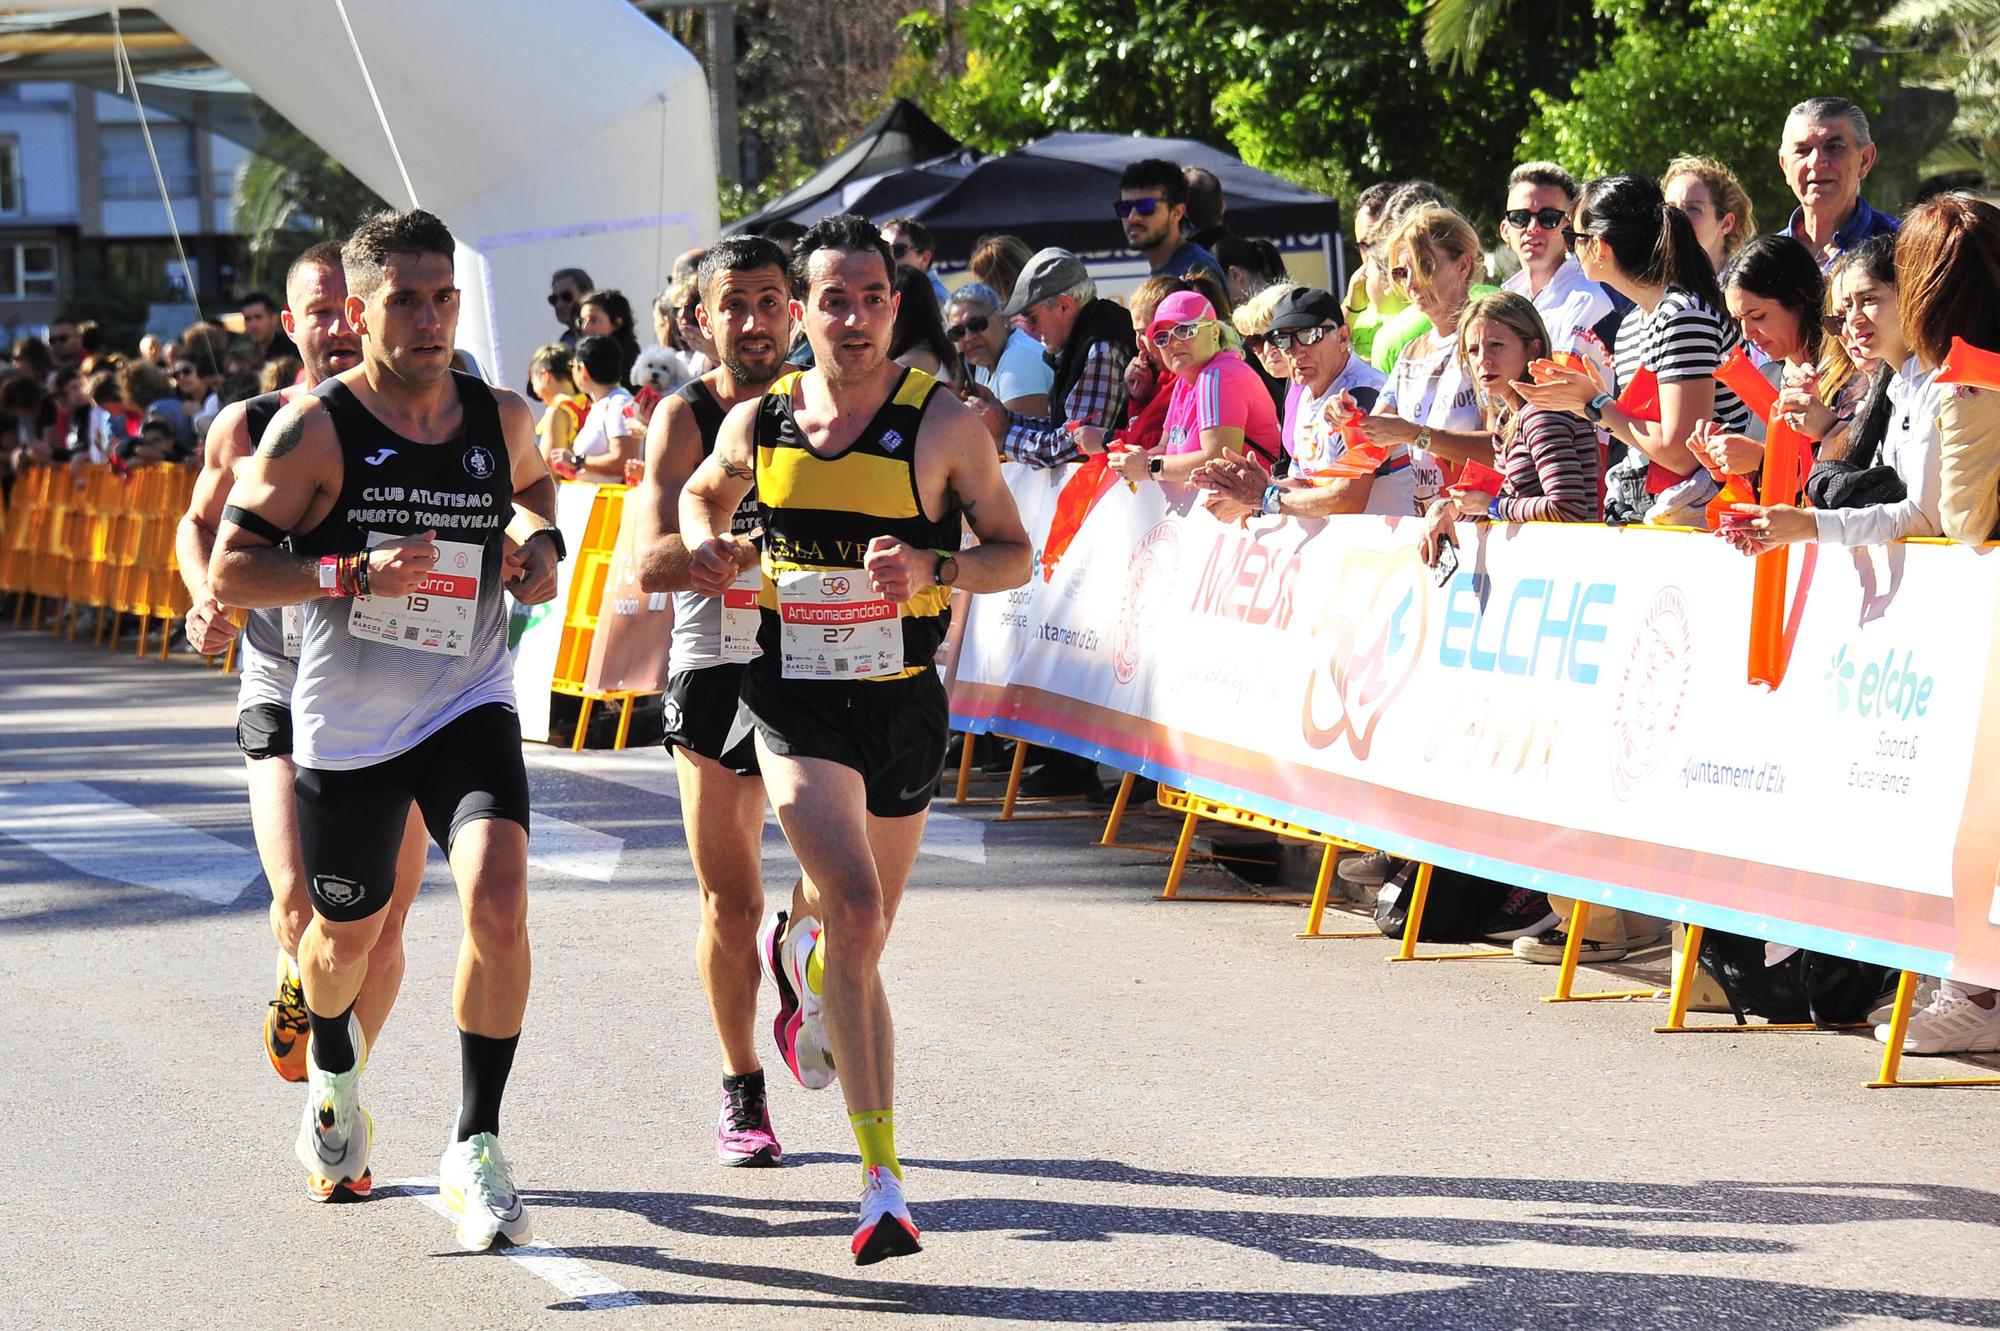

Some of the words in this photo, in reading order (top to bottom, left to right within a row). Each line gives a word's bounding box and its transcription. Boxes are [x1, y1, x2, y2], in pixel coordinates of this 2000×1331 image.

[362, 487, 404, 501] CLUB
[409, 489, 493, 508] ATLETISMO
[347, 509, 409, 524] PUERTO
[414, 511, 499, 528] TORREVIEJA
[835, 541, 868, 563] VE
[418, 579, 454, 593] orro
[406, 595, 429, 612] 19
[788, 603, 891, 621] Arturomacanddon
[823, 627, 856, 643] 27
[1439, 572, 1616, 685] ELCHE
[1858, 647, 1934, 722] elche
[1875, 730, 1908, 761] Sport
[1679, 756, 1754, 790] Ajuntament
[1848, 762, 1911, 794] Experience
